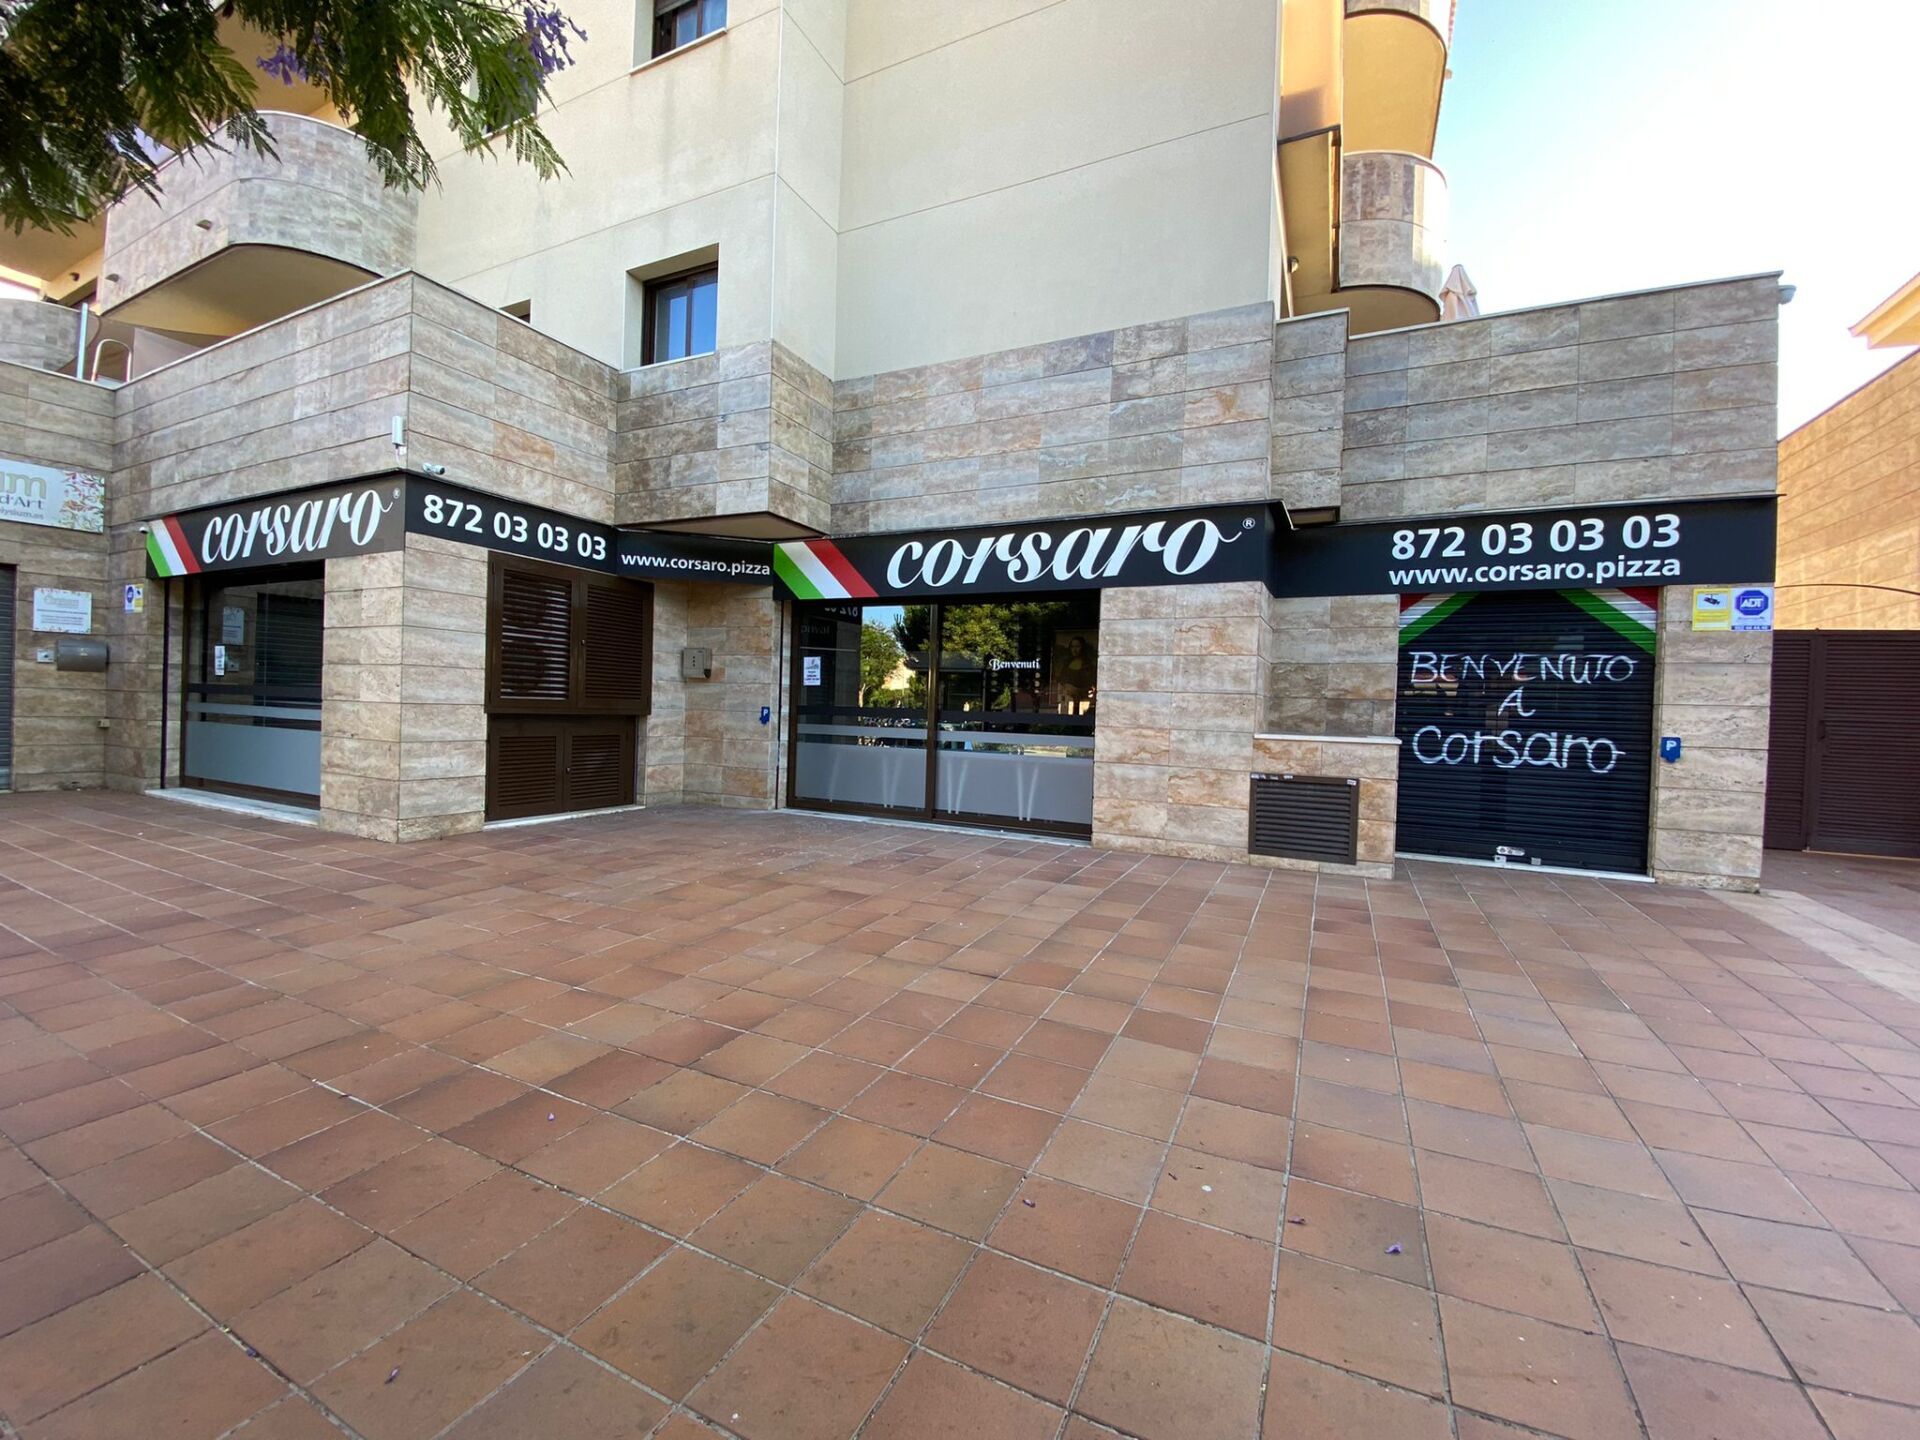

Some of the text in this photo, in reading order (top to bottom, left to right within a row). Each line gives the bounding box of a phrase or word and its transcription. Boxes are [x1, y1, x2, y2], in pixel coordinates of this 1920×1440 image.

[0, 471, 47, 499] m
[202, 490, 394, 564] corsaro
[423, 494, 607, 560] 872 03 03 03
[1391, 514, 1680, 560] 872 03 03 03
[621, 554, 771, 576] www.corsaro.pizza
[887, 519, 1242, 589] corsaro
[1389, 555, 1681, 584] www.corsaro.pizza
[1741, 598, 1764, 608] ADT
[988, 658, 1041, 671] Benvenuti
[1408, 652, 1639, 684] BENVENUTO
[1497, 686, 1536, 717] A
